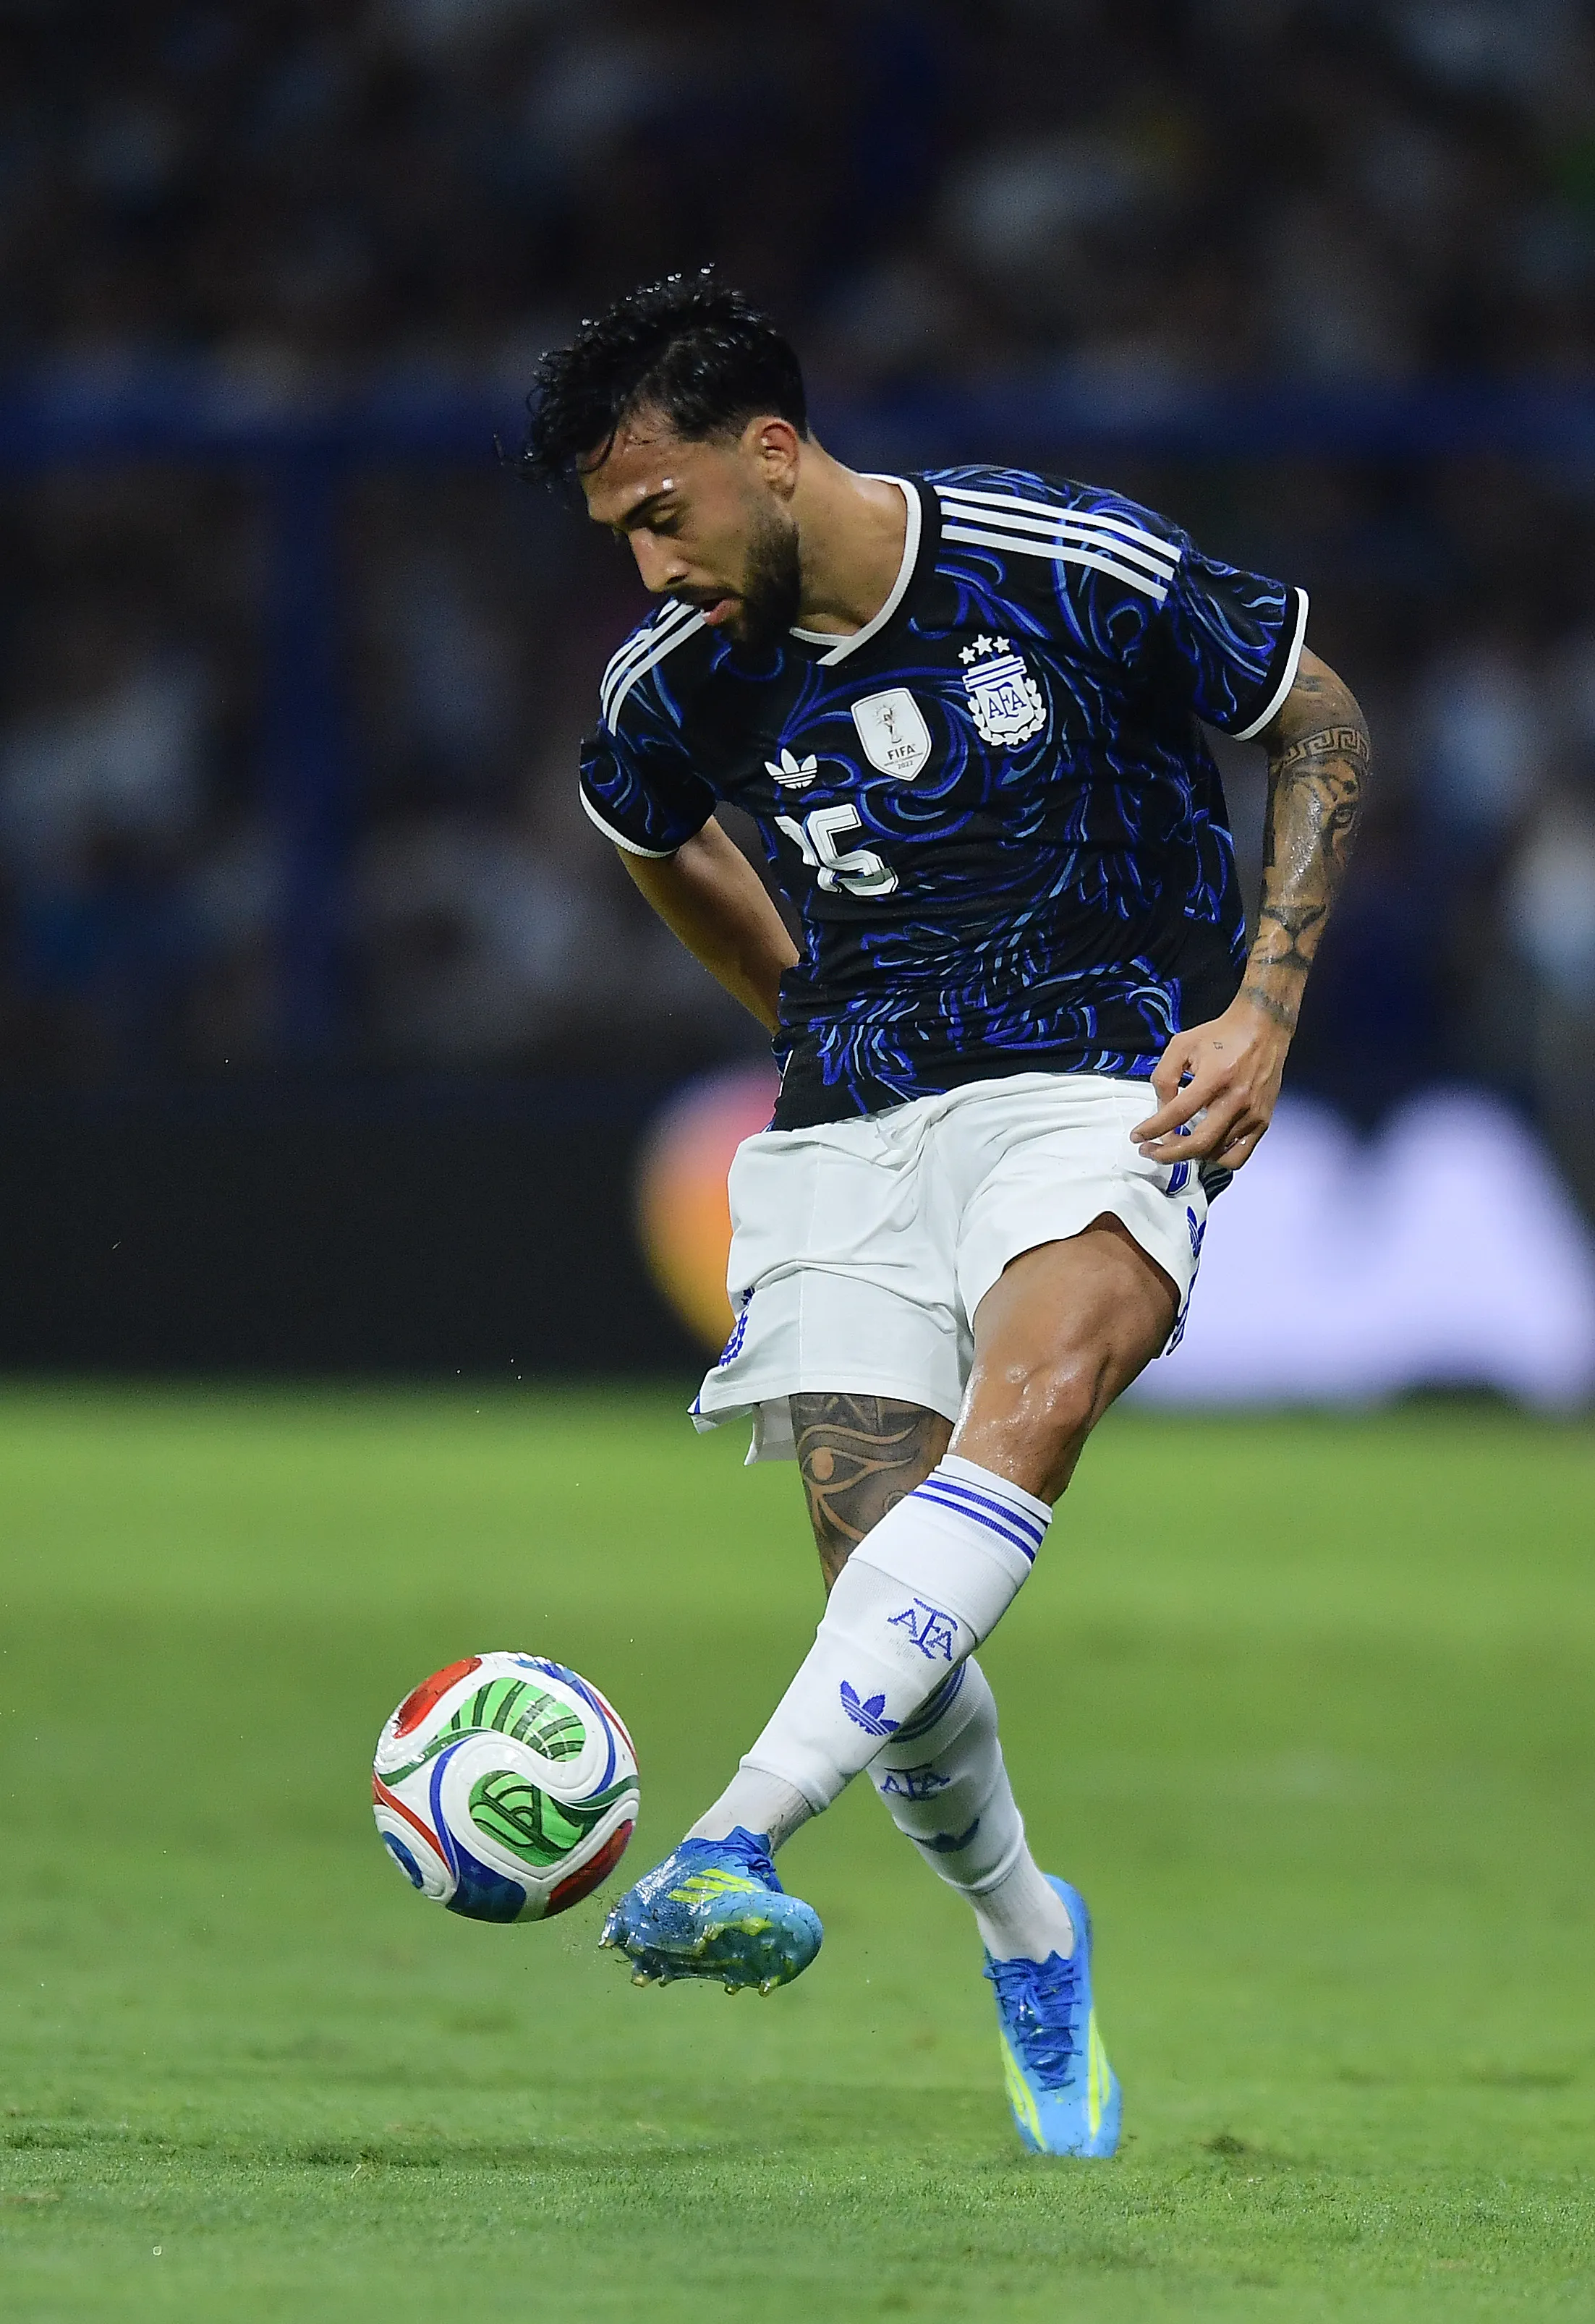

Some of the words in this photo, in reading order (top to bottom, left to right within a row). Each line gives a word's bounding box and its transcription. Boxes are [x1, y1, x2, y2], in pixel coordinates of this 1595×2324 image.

[984, 681, 1027, 720] AFA
[887, 744, 915, 760] FIFA
[898, 760, 914, 770] 2022
[774, 804, 898, 896] 15
[887, 1597, 958, 1661] AFA
